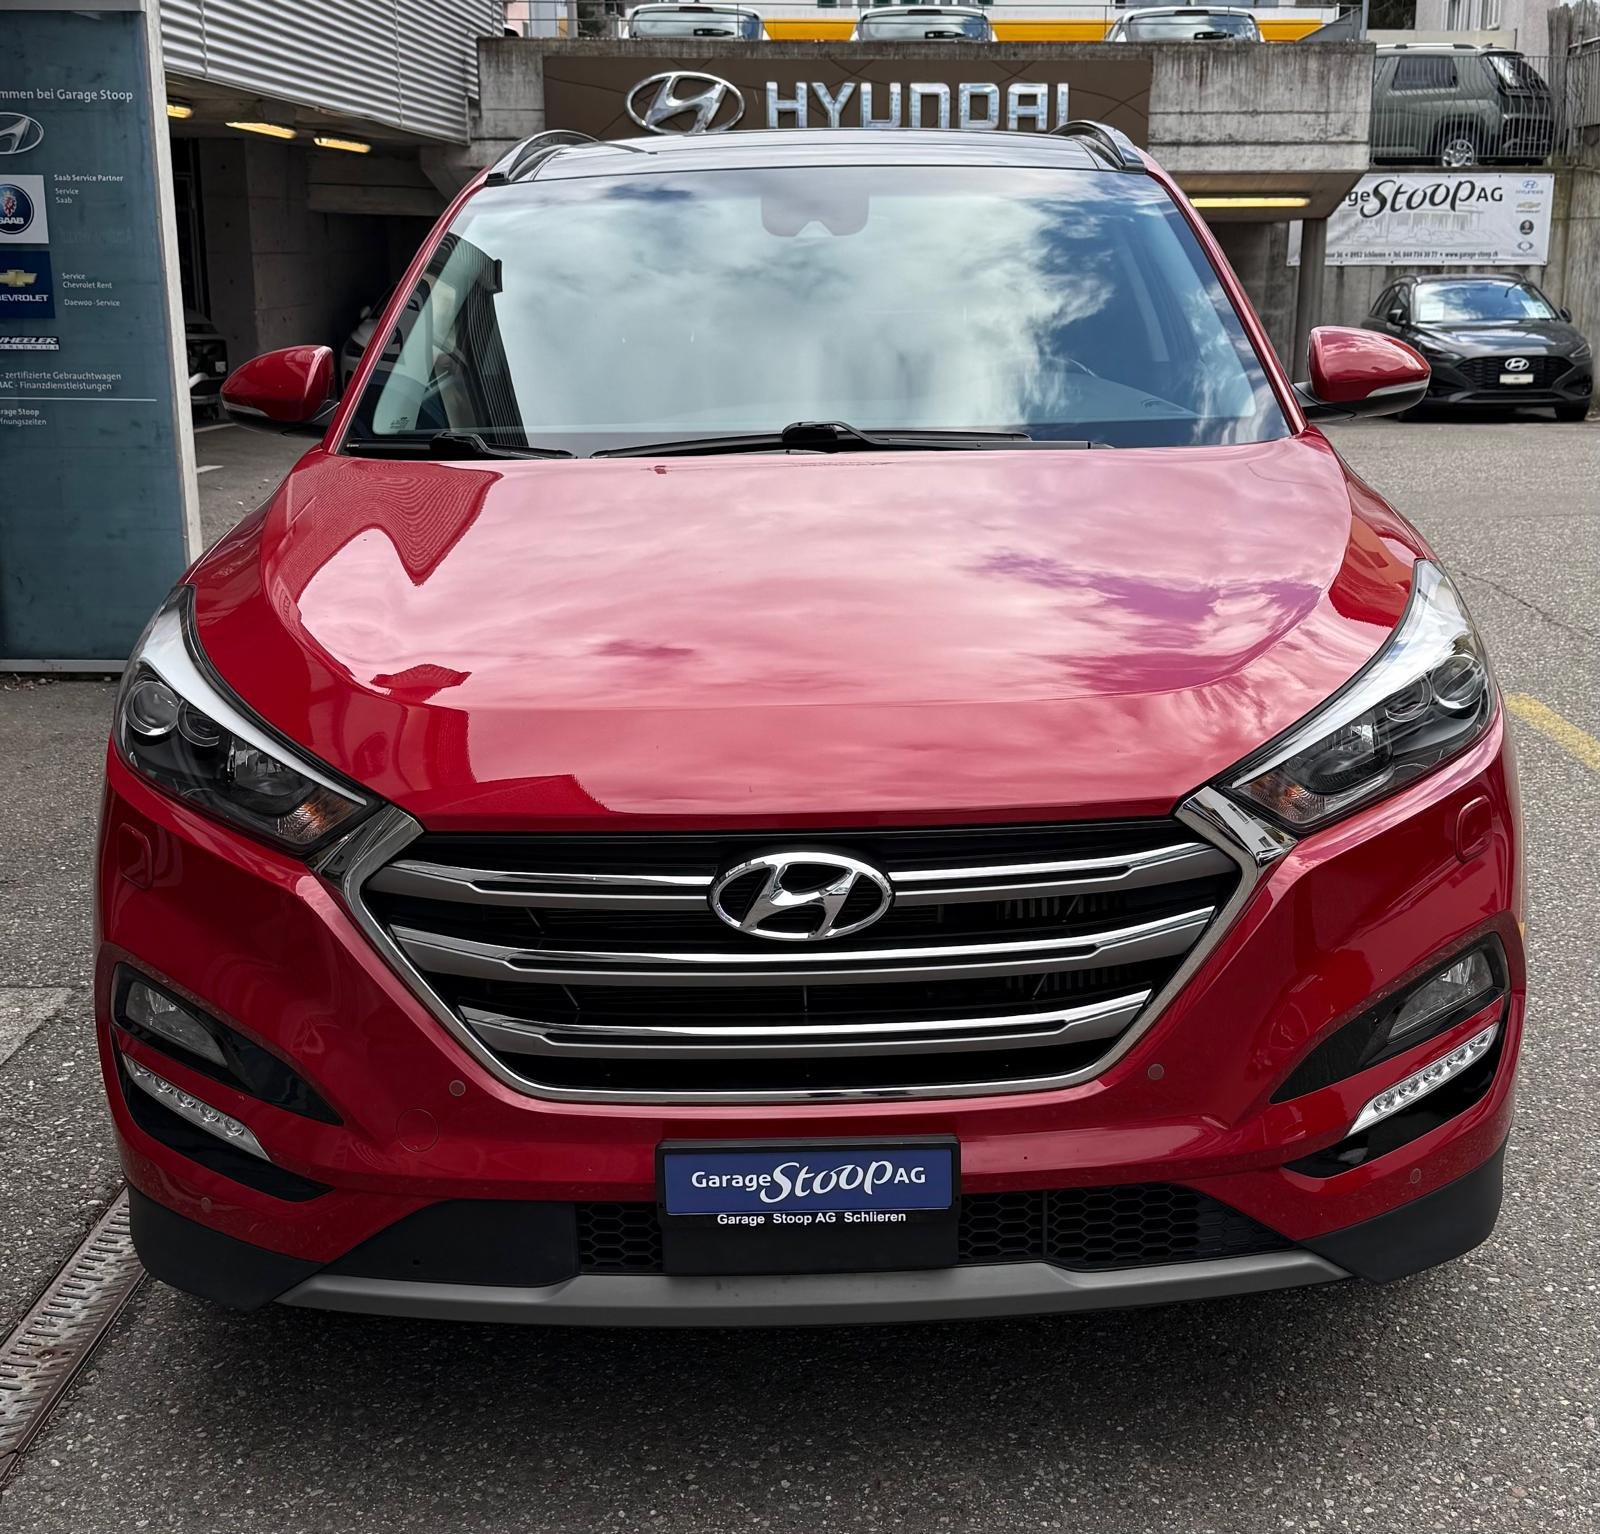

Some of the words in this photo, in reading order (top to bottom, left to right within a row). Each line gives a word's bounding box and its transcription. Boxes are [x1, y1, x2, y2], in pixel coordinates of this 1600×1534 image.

[36, 88, 55, 100] bei
[56, 89, 98, 103] Garage
[99, 89, 133, 103] Stoop
[766, 81, 1069, 131] HYUNDAI
[72, 174, 97, 182] Service
[97, 174, 124, 182] Partner
[55, 187, 79, 195] Service
[55, 196, 73, 204] Saab
[1359, 179, 1476, 218] Stoop
[1476, 187, 1504, 202] AG
[62, 272, 86, 280] Service
[62, 281, 96, 289] Chevrolet
[96, 281, 113, 289] Rent
[0, 294, 48, 302] EVROLET
[5, 371, 52, 380] zertifizierte
[52, 371, 122, 382] Gebrauchtwagen
[19, 381, 112, 392] Finanzdienstleistungen
[17, 408, 40, 417] Stoop
[691, 1170, 771, 1191] Garage
[759, 1160, 894, 1204] Stoop
[893, 1166, 927, 1185] AG
[717, 1213, 766, 1226] Garage
[772, 1212, 813, 1226] Stoop
[815, 1212, 837, 1223] AG
[843, 1211, 907, 1223] Schlieren
